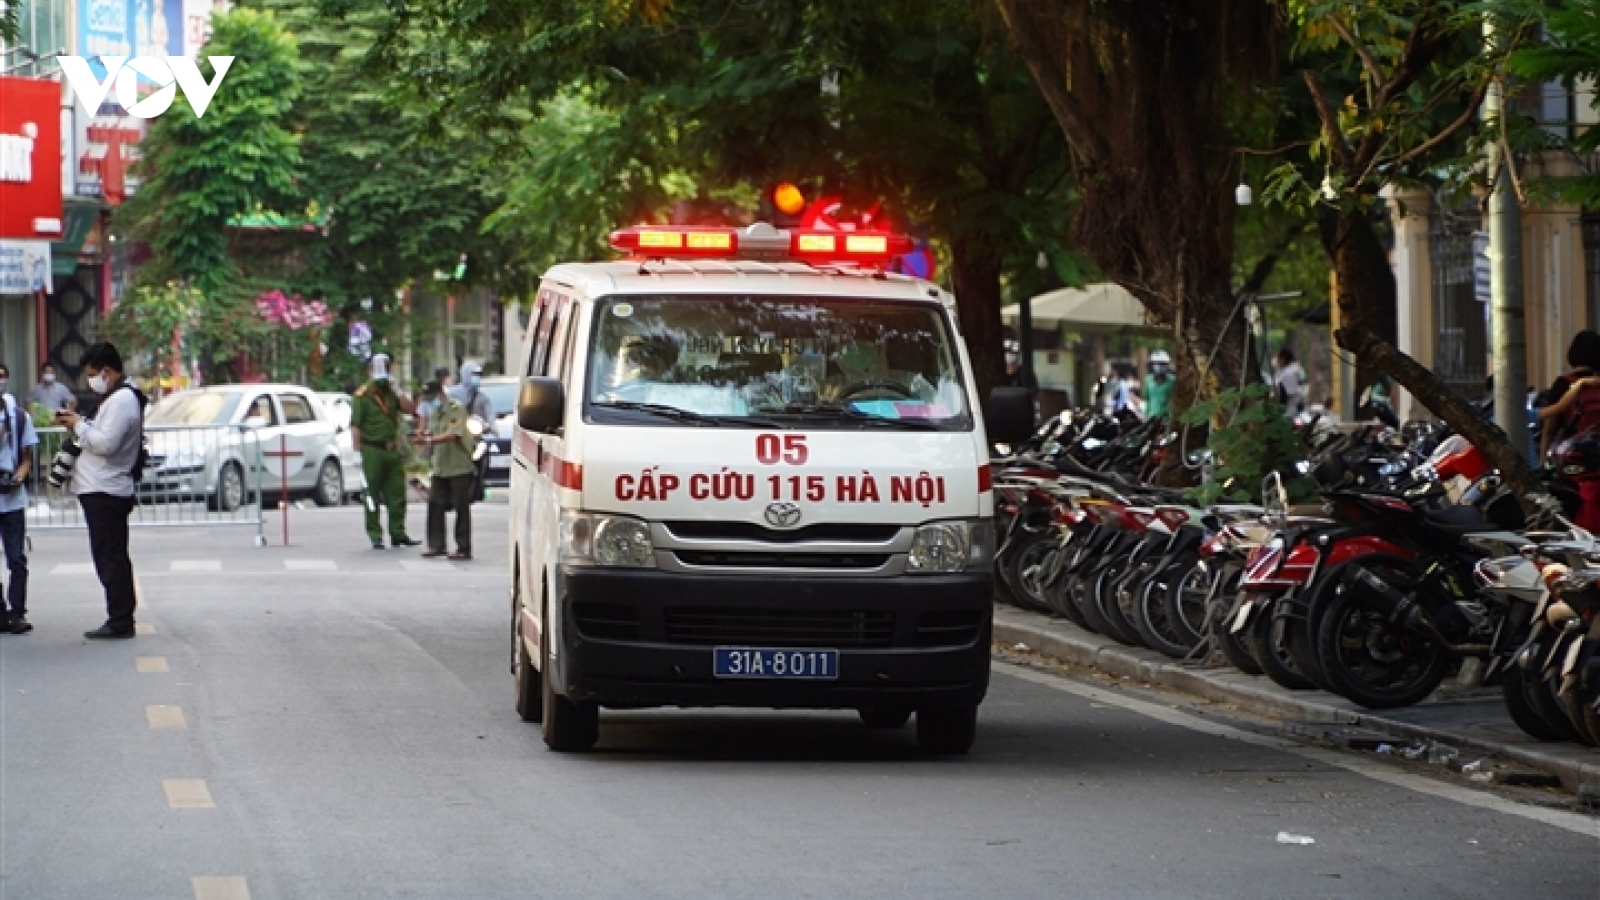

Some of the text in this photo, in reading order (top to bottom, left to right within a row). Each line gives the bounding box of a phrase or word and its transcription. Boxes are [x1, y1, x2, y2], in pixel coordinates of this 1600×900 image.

[755, 433, 809, 465] 05
[614, 465, 947, 508] CẤP CỨU 115 HÀ NỘI
[728, 651, 828, 675] 31A-8011
